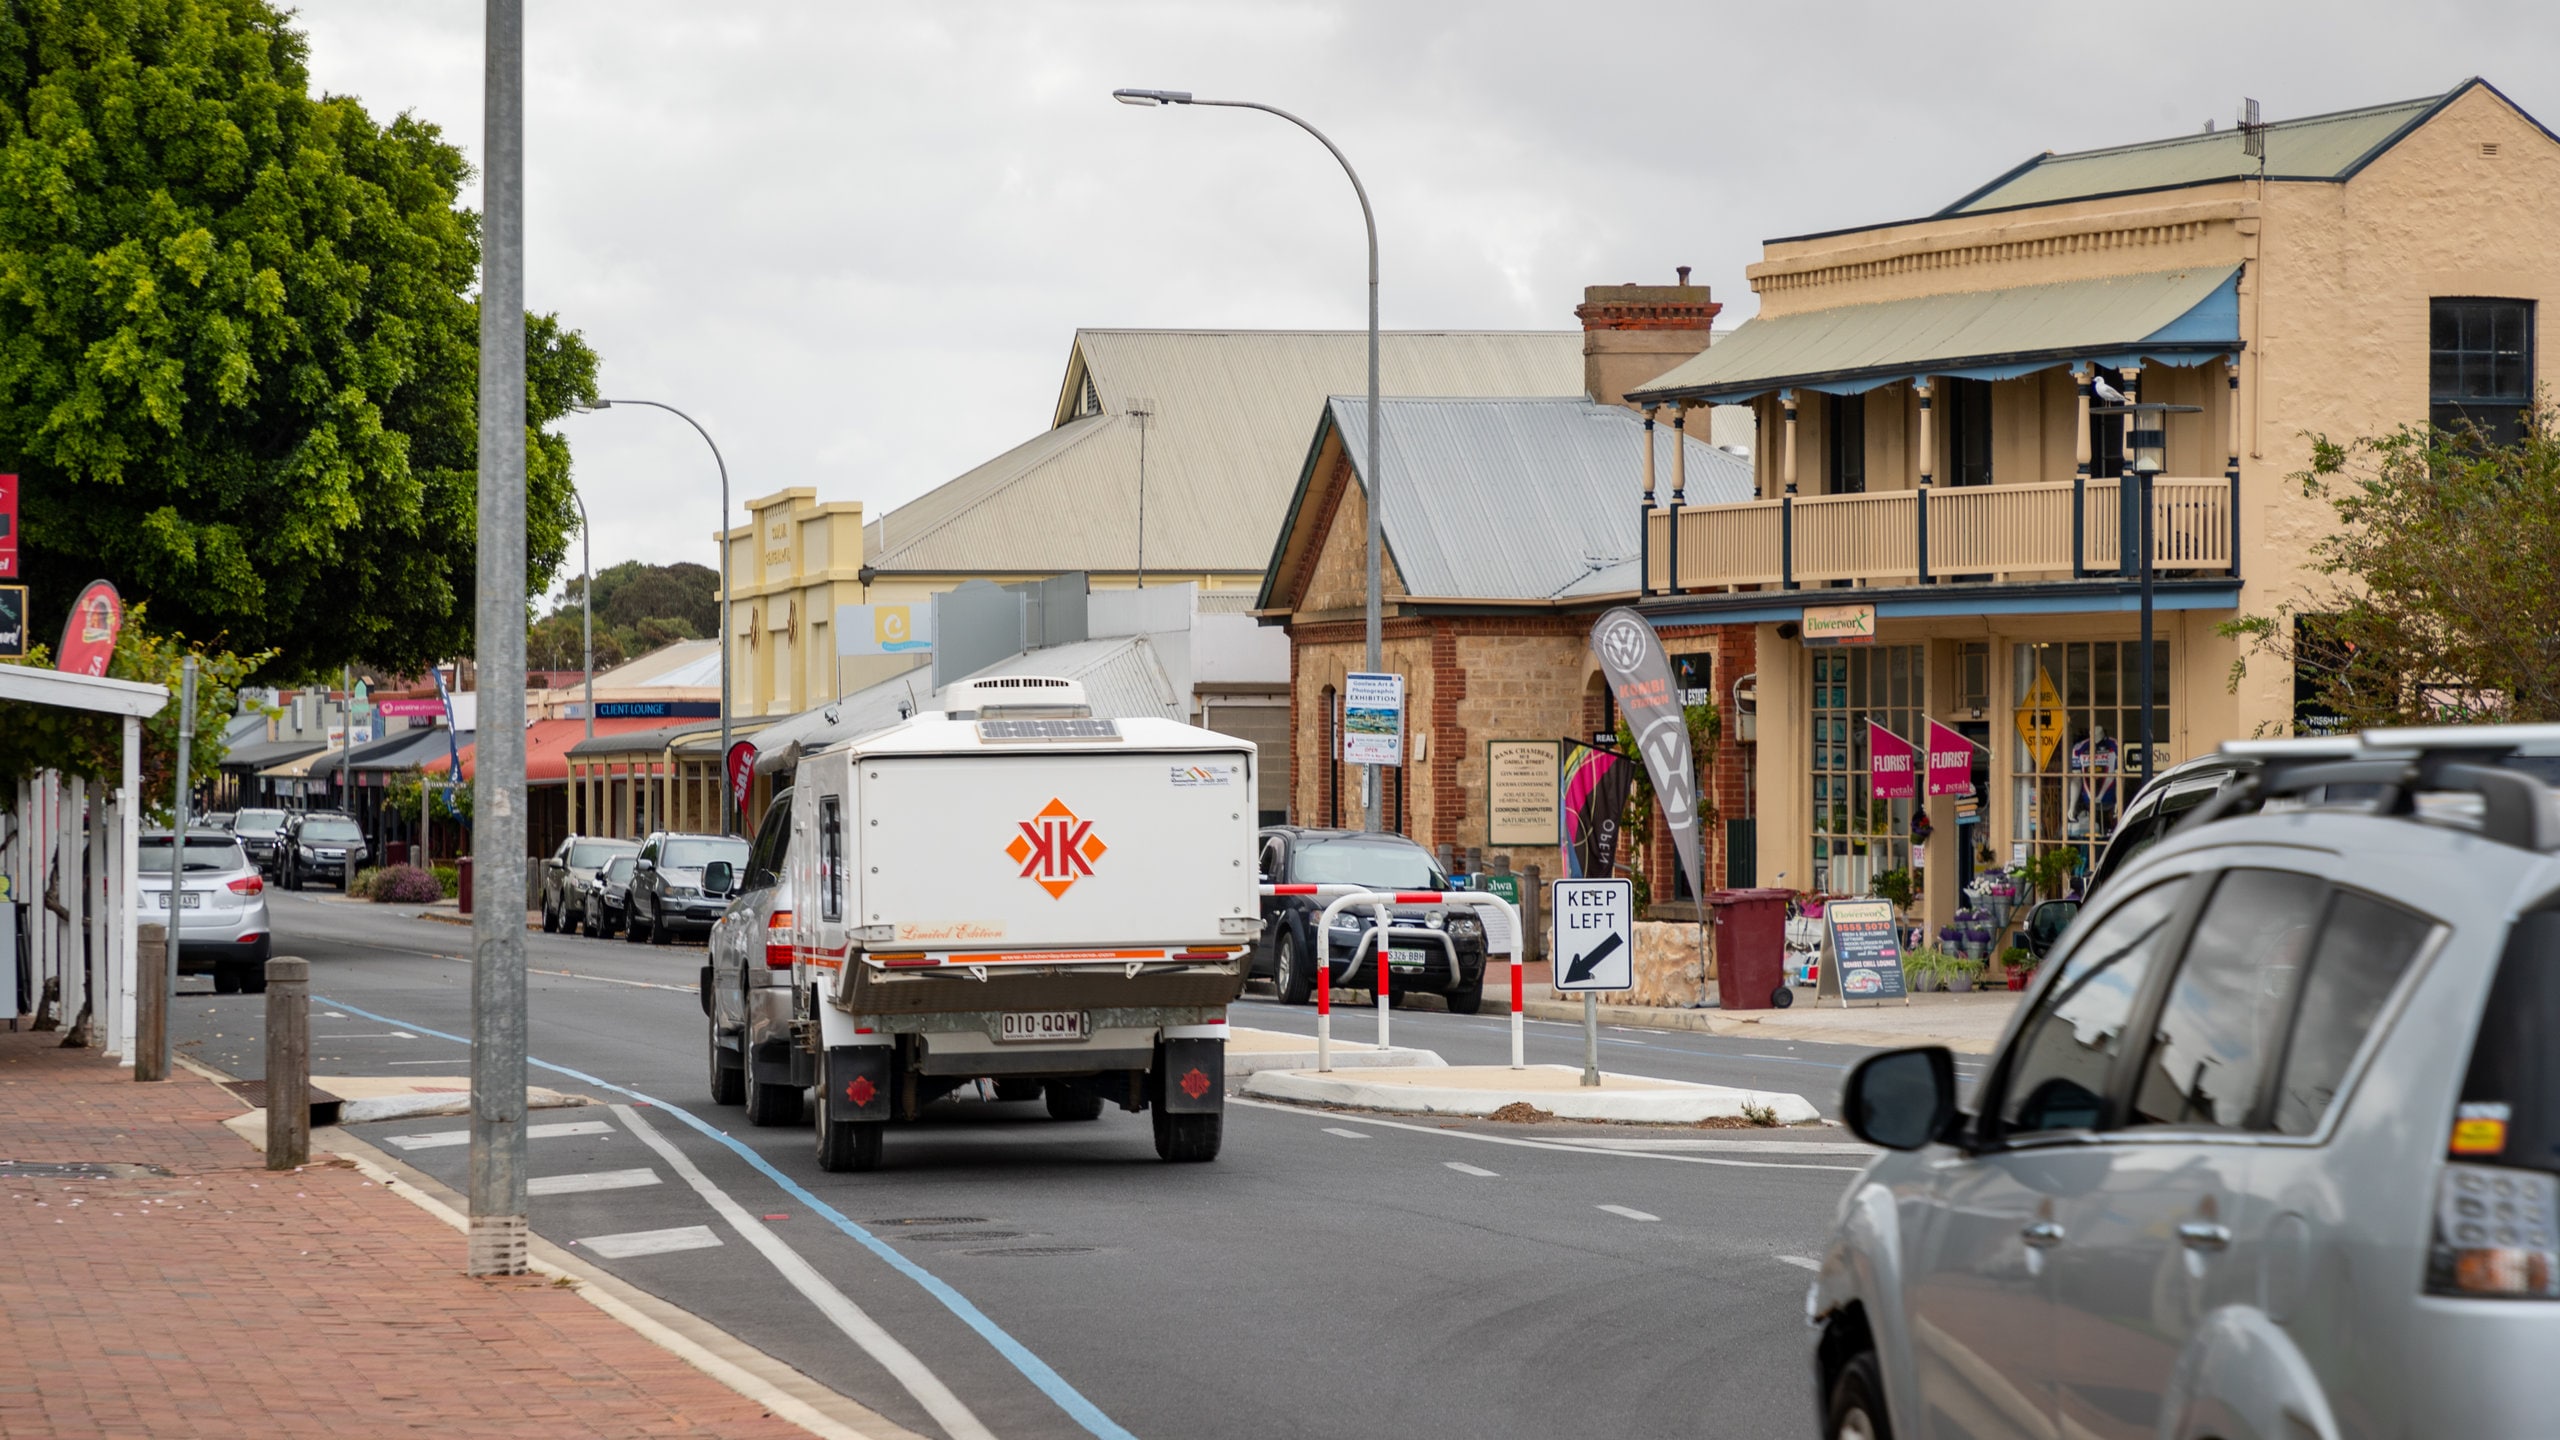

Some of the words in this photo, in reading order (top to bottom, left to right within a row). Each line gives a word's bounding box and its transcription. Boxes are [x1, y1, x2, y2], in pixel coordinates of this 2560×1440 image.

[1619, 679, 1665, 698] KOMBI
[394, 702, 419, 712] priceline
[600, 703, 629, 715] CLIENT
[630, 703, 664, 714] LOUNGE
[1630, 695, 1669, 709] STATION
[1596, 734, 1614, 742] REAL
[1494, 749, 1514, 760] BANK
[1515, 748, 1554, 760] CHAMBERS
[1931, 751, 1970, 769] FLORIST
[2153, 749, 2170, 763] Sho
[1873, 754, 1911, 772] FLORIST
[736, 751, 753, 801] SALE
[1890, 784, 1914, 796] petals
[1945, 780, 1969, 794] petals
[1568, 890, 1617, 906] KEEP
[1570, 913, 1615, 929] LEFT
[901, 924, 951, 941] Limited
[954, 923, 1004, 940] Edition
